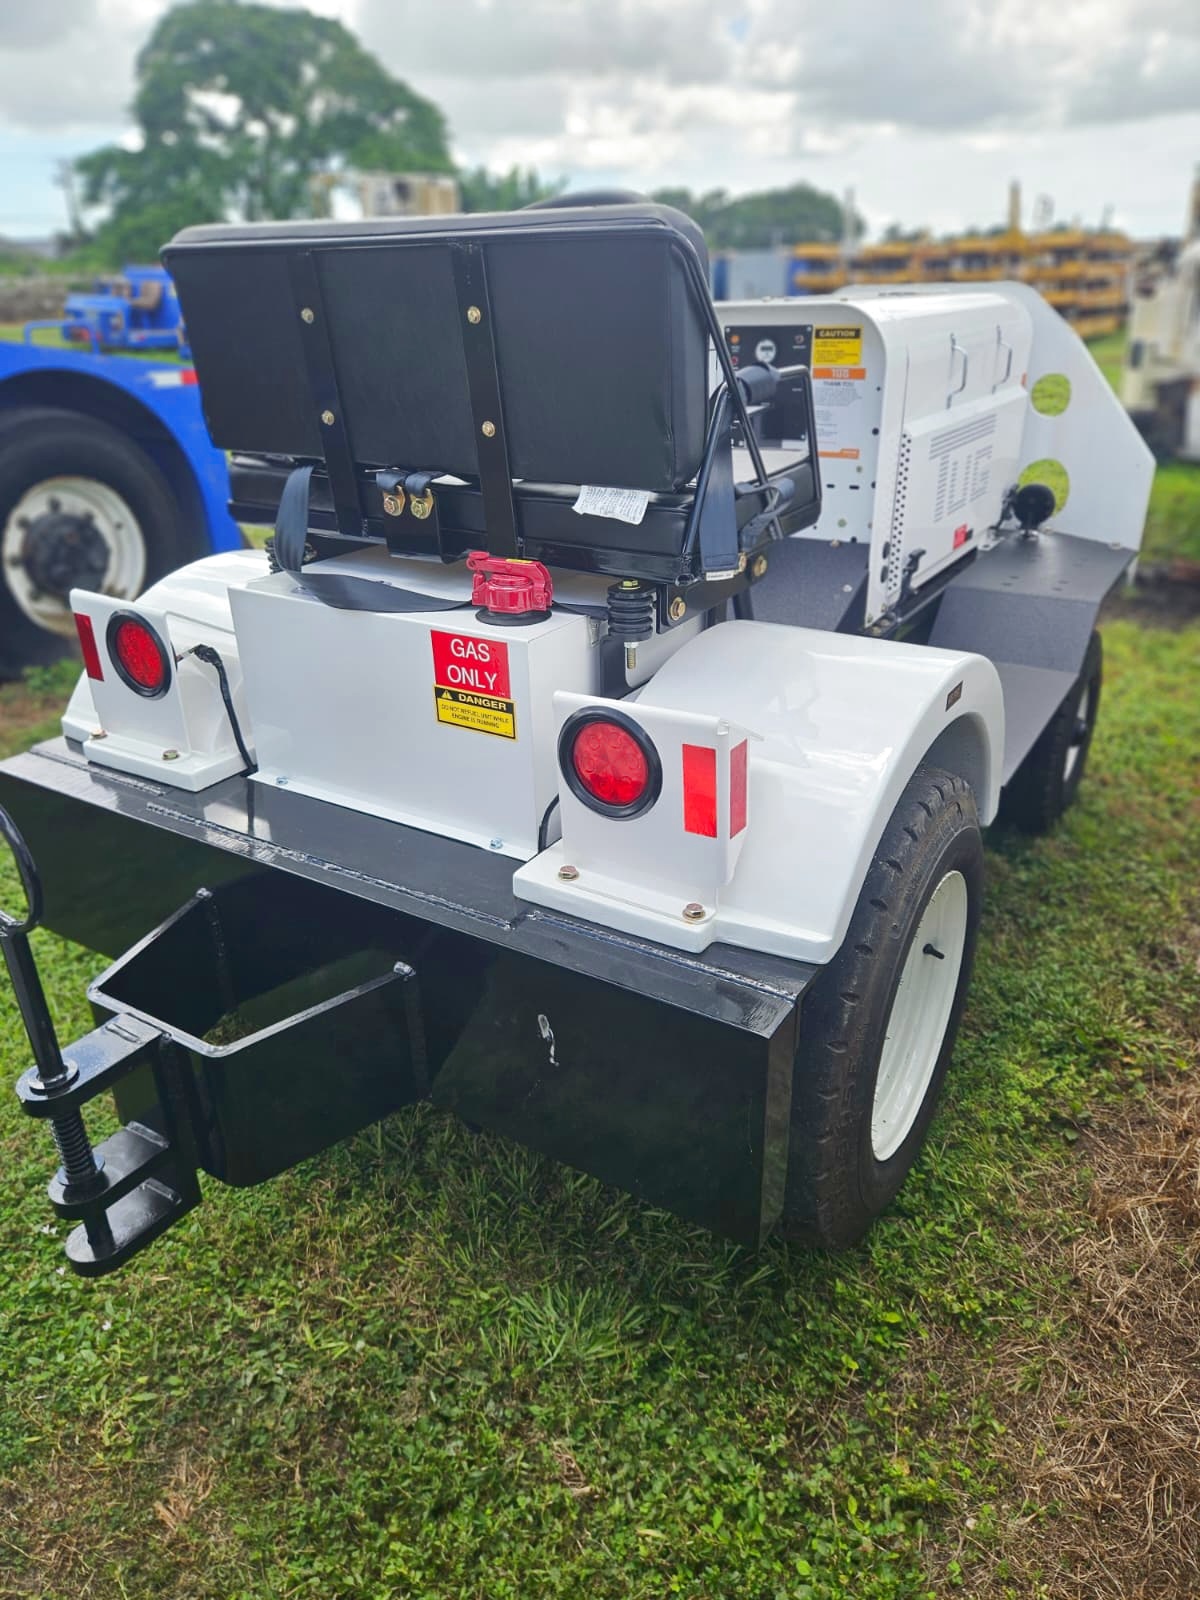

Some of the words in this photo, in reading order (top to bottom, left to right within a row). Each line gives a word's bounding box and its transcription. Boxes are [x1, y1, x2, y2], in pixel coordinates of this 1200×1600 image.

[450, 638, 490, 662] GAS
[447, 665, 497, 690] ONLY
[458, 693, 506, 710] DANGER
[451, 712, 470, 722] ENGINE
[476, 718, 500, 728] RUNNING
[460, 708, 479, 718] REFUEL
[481, 712, 493, 720] UNIT
[493, 714, 509, 724] WHILE
